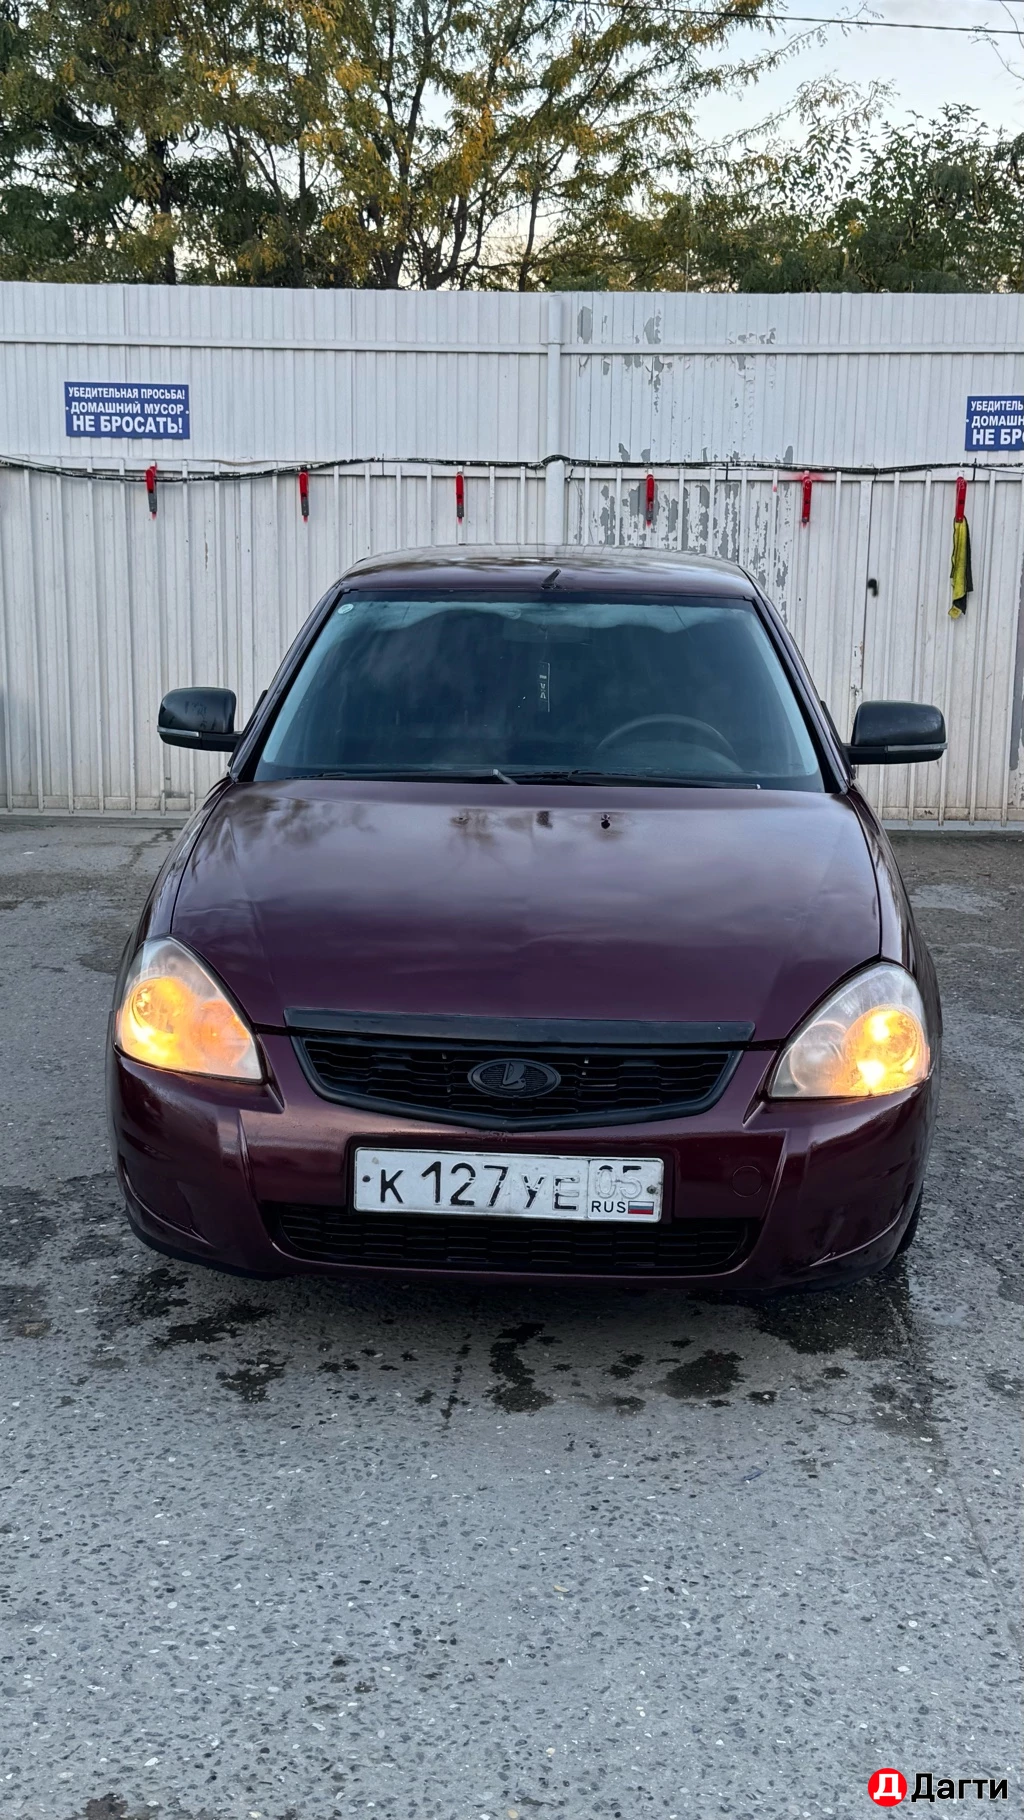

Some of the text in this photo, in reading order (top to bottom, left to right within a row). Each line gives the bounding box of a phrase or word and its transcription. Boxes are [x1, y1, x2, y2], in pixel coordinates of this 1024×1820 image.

[68, 387, 185, 400] УБЕДИТЕЛЬНАЯ ПРОСЬБА!
[71, 401, 184, 415] ДОМАШНИЙ МУСОР
[971, 400, 1024, 412] УБЕДИТЕЛЬ
[72, 415, 183, 434] НЕ БРОСАТЬ!
[972, 428, 1024, 445] НЕ БР
[595, 1164, 643, 1200] 05
[591, 1200, 626, 1214] RUS
